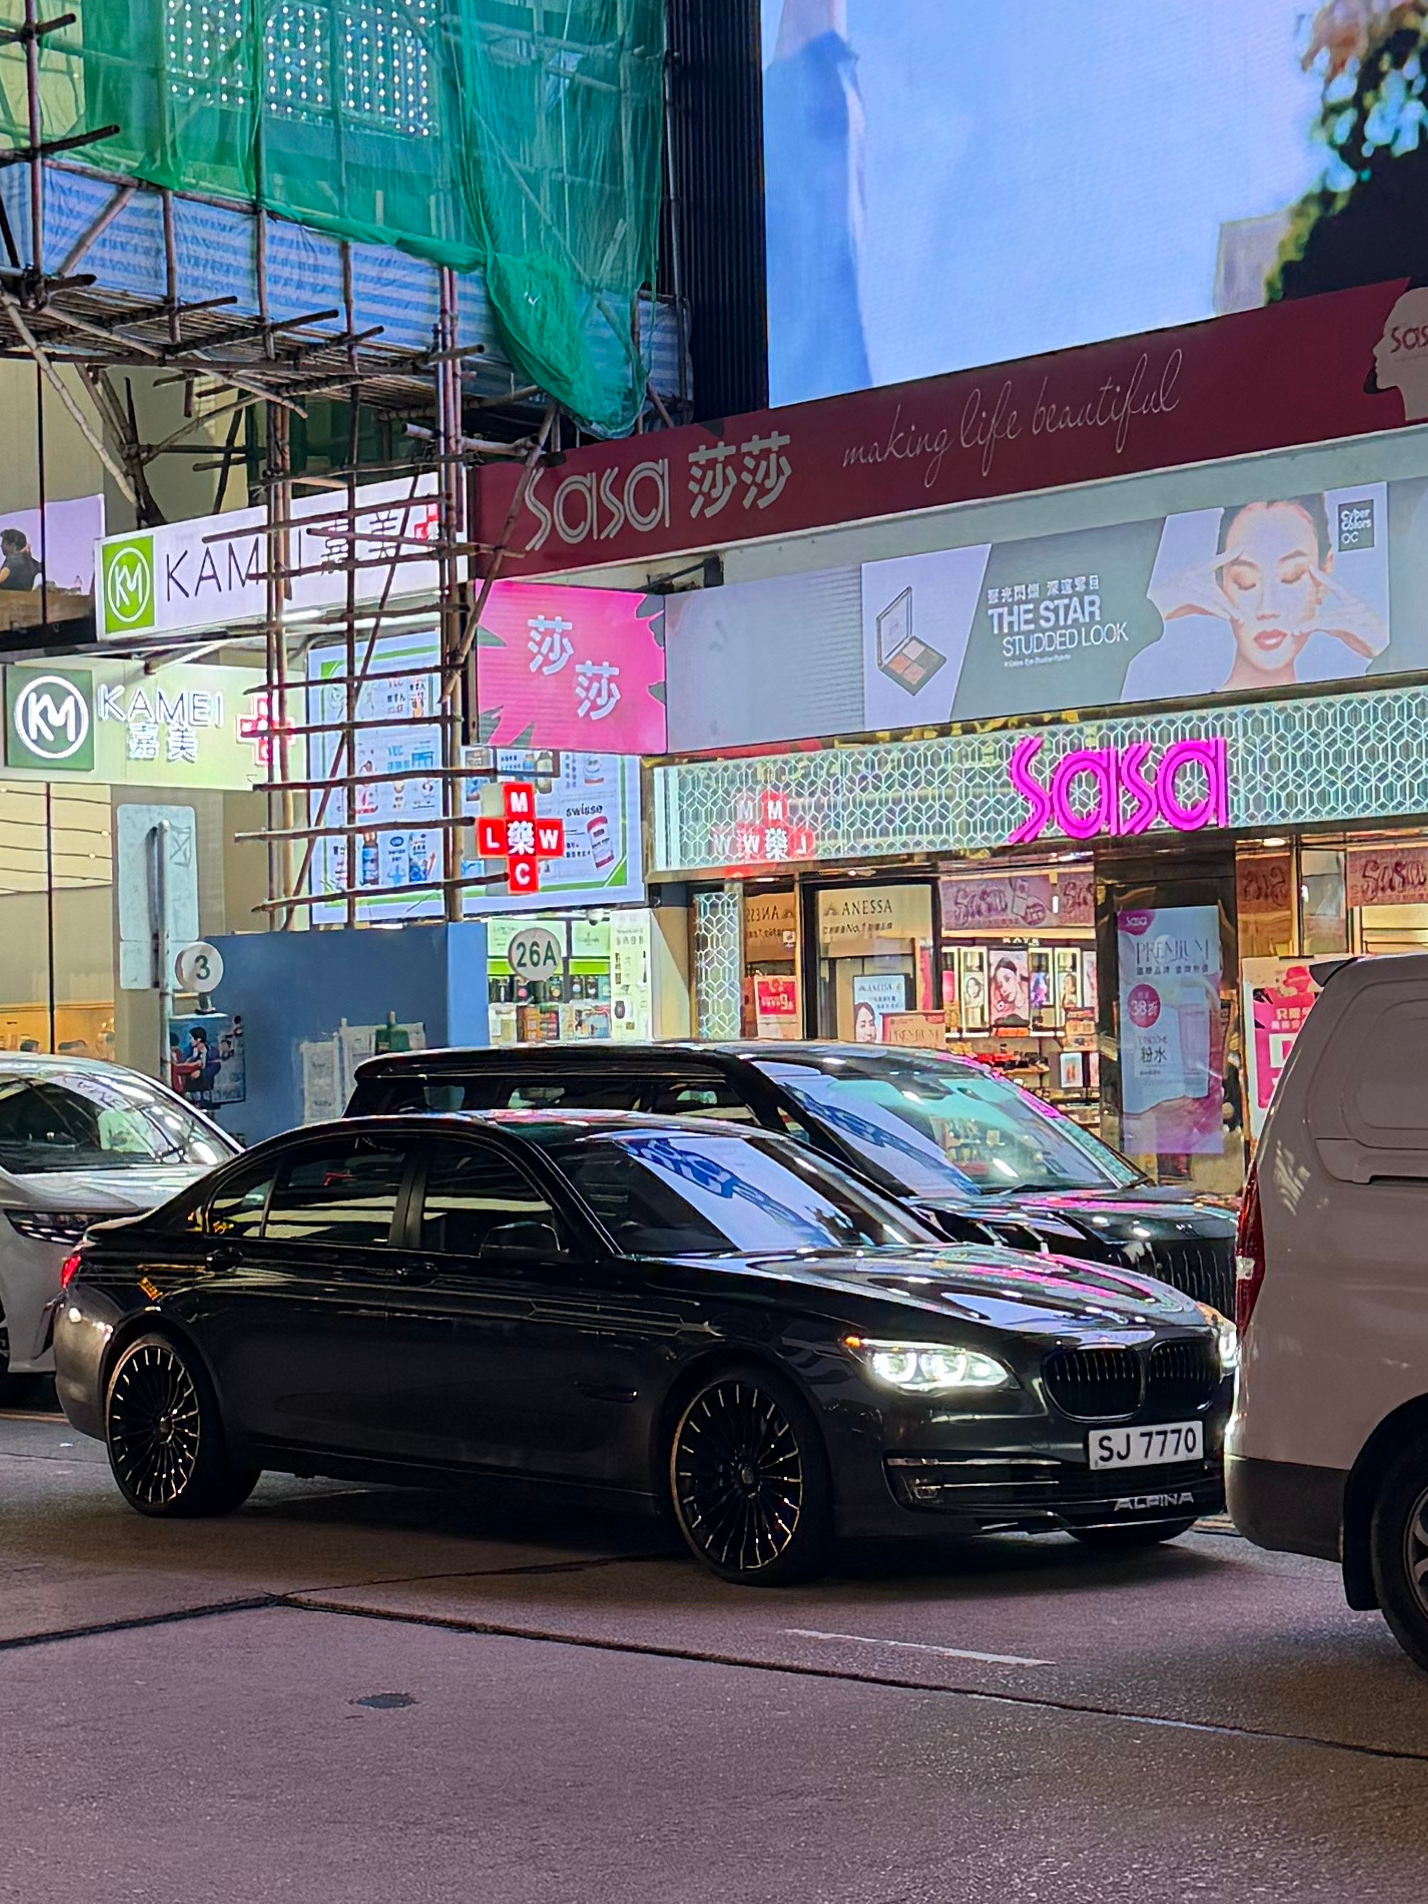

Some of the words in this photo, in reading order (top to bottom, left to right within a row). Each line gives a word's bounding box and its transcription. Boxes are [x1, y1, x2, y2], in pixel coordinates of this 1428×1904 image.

[842, 403, 952, 488] making
[960, 380, 1021, 477] life
[1031, 348, 1183, 454] beautiful
[688, 431, 792, 518] 莎莎
[1341, 519, 1372, 532] Colors
[166, 528, 301, 602] KAMI
[988, 603, 1035, 635] THE
[1039, 595, 1101, 630] STAR
[1002, 629, 1079, 657] STUDDED
[1081, 622, 1129, 647] LOOK
[528, 615, 621, 720] 莎莎
[98, 684, 225, 728] KAMEI
[127, 721, 198, 763] 嘉美
[510, 791, 529, 813] M
[486, 827, 500, 848] L
[507, 820, 535, 855] 藥
[539, 829, 559, 849] W
[515, 863, 531, 885] C
[842, 899, 892, 916] ANESSA
[195, 955, 211, 980] 3
[516, 941, 557, 968] 26A
[1136, 938, 1209, 965] PREMIUM
[1098, 1432, 1131, 1463] SJ
[1139, 1427, 1197, 1459] 7770
[1113, 1492, 1194, 1512] ALPINA
